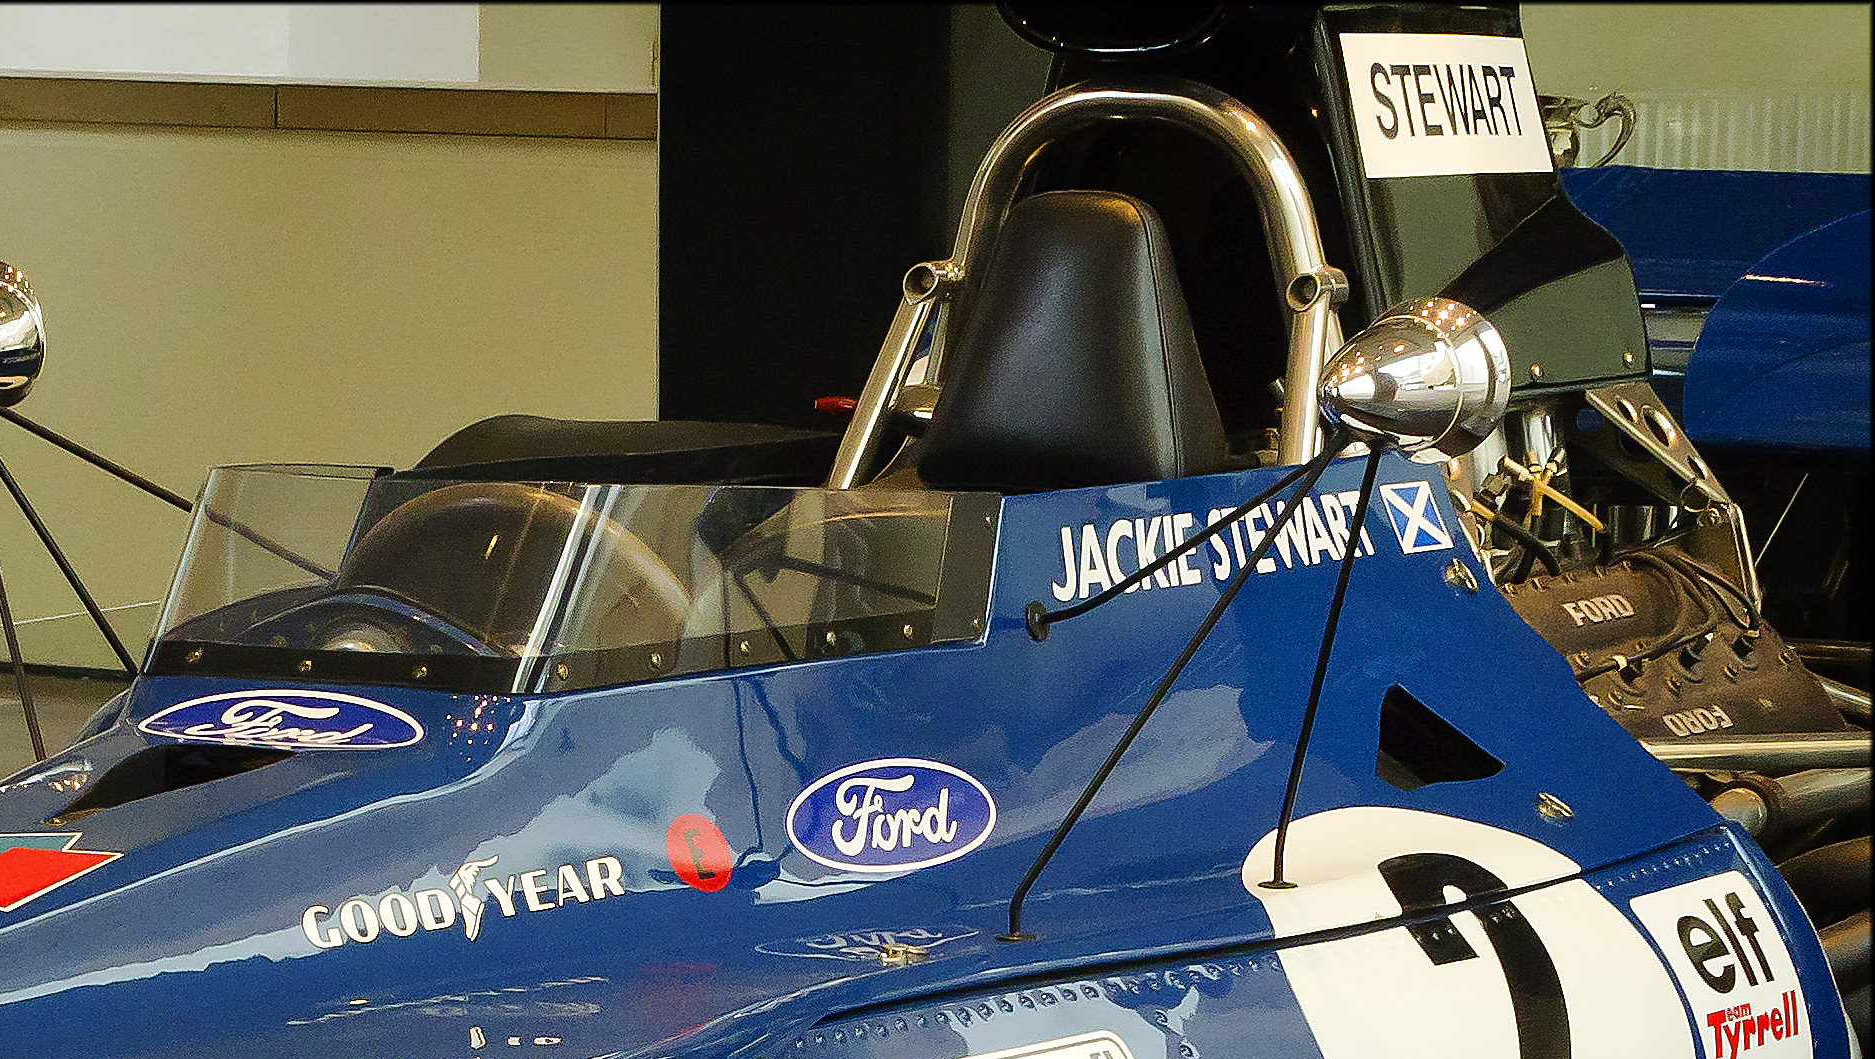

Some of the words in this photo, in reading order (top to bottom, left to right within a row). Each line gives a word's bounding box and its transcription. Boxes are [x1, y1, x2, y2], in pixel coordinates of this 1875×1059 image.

[1370, 62, 1522, 140] STEWART
[1052, 513, 1202, 602] JACKIE
[1205, 490, 1375, 580] STEWART
[1561, 594, 1635, 627] FORD
[184, 699, 373, 746] Ford
[1662, 705, 1734, 737] FORD
[831, 774, 958, 857] Ford
[684, 828, 716, 880] E
[1676, 891, 1775, 994] elf
